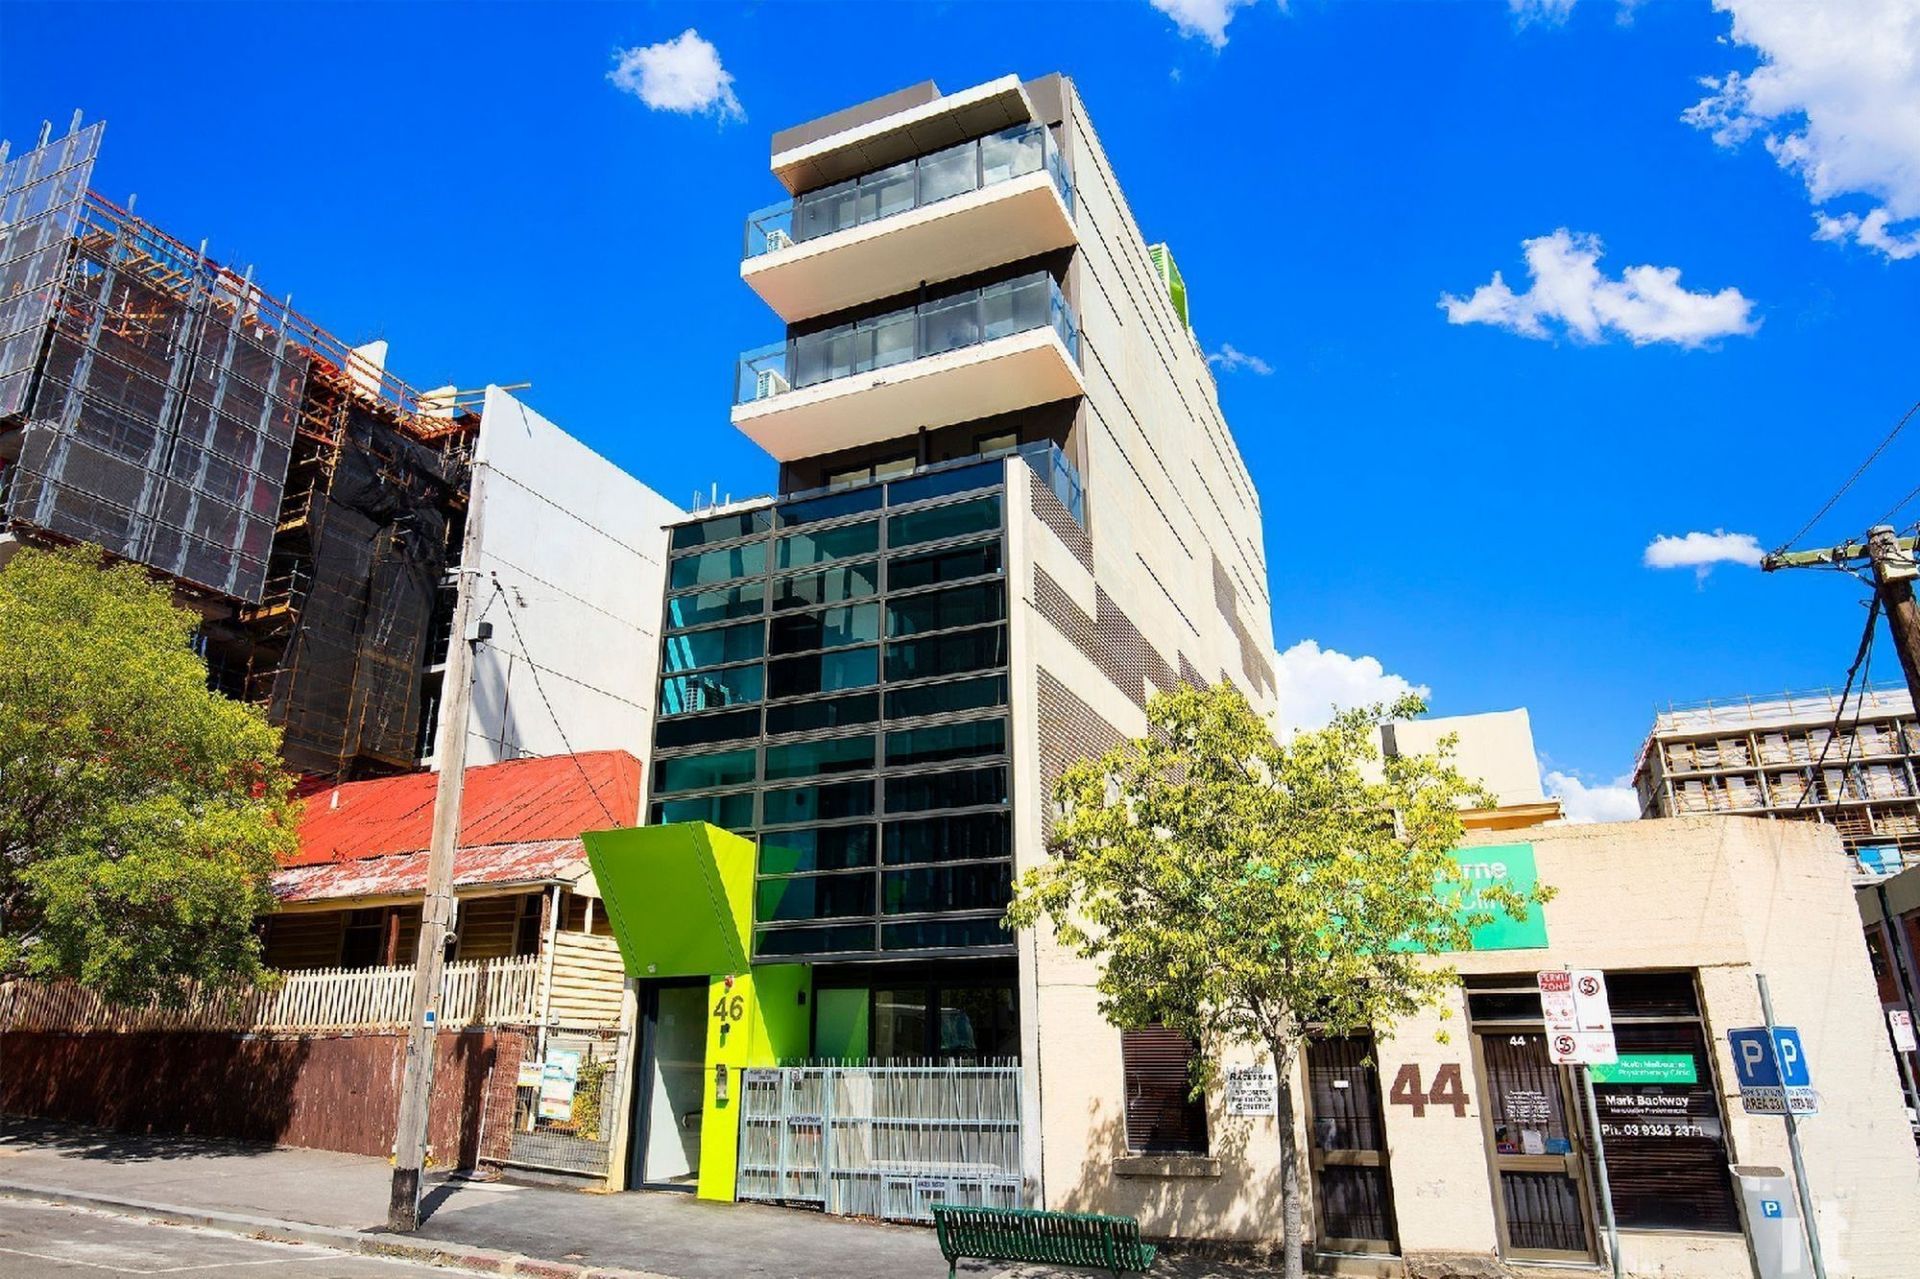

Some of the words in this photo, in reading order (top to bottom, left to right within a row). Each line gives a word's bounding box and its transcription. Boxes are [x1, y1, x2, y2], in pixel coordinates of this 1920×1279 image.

[1541, 983, 1571, 992] ZONE
[713, 995, 744, 1022] 46
[1510, 1035, 1526, 1047] 44
[1740, 1040, 1764, 1078] P
[1780, 1038, 1797, 1077] P
[1390, 1064, 1470, 1117] 44
[1605, 1095, 1635, 1106] Mark
[1637, 1095, 1689, 1107] Backway
[1624, 1124, 1638, 1136] 03
[1642, 1125, 1672, 1137] 9328
[1674, 1125, 1704, 1137] 2371
[1765, 1202, 1778, 1216] P
